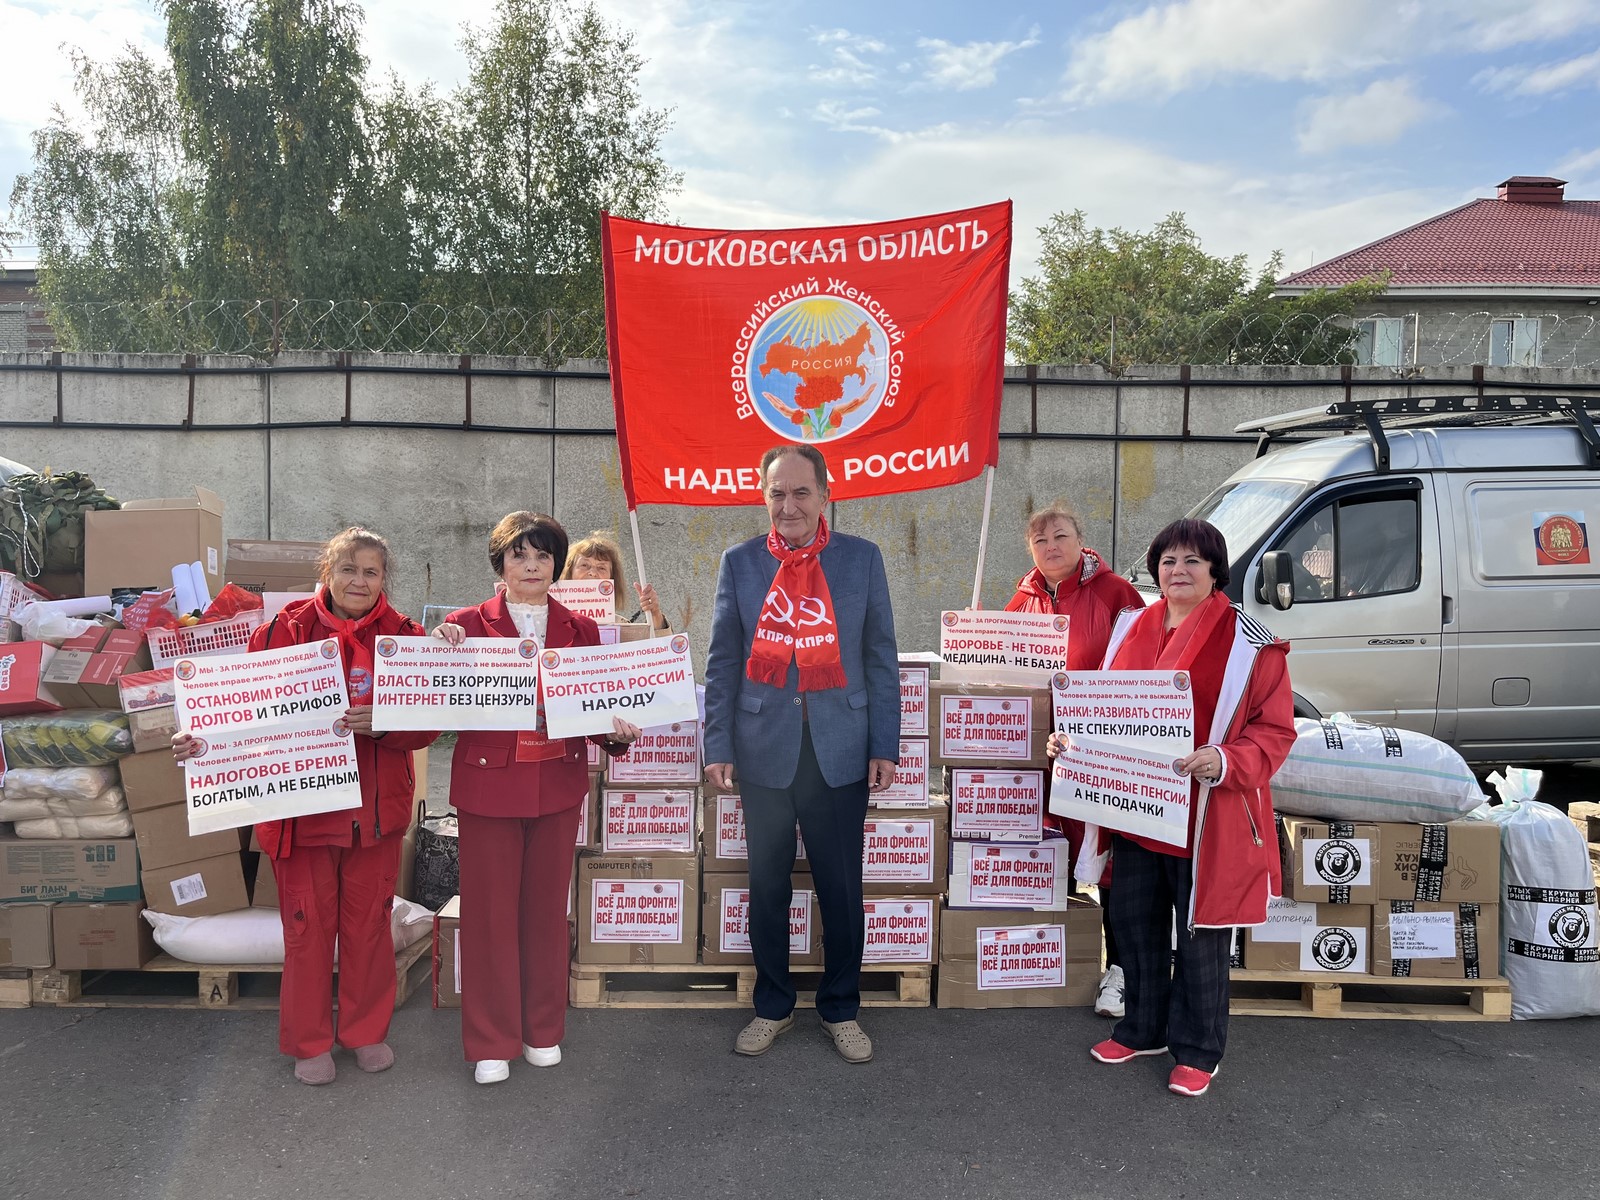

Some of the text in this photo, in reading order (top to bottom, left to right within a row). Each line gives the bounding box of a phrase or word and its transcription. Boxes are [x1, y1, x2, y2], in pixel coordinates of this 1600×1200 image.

[635, 220, 989, 267] МОСКОВСКАЯ ОБЛАСТЬ
[731, 277, 905, 420] Всероссийский Женский Союз
[792, 356, 852, 369] РОССИЯ
[844, 442, 969, 480] РОССИИ
[757, 628, 793, 645] КПРФ
[795, 633, 835, 649] КПРФ
[592, 646, 668, 661] ПРОГРАММУ ПОБЕДЫ!
[944, 640, 1066, 656] ЗДОРОВЬЕ НЕ ТОВАР,
[231, 652, 318, 671] ПРОГРАММУ ПОБЕДЫ!
[582, 668, 608, 676] вправе
[648, 655, 685, 667] выживать!
[943, 654, 1066, 670] МЕДИЦИНА НЕ БАЗАР
[378, 675, 536, 690] ВЛАСТЬ БЕЗ КОРРУПЦИИ
[546, 670, 684, 698] БОГАТСТВА РОССИИ
[186, 688, 272, 710] ОСТАНОВИМ
[275, 682, 309, 698] РОСТ
[312, 676, 339, 693] ЦЕН,
[378, 693, 534, 707] ИНТЕРНЕТ БЕЗ ЦЕНЗУРЫ
[582, 692, 655, 712] НАРОДУ
[190, 693, 341, 730] ДОЛГОВ И ТАРИФОВ
[947, 710, 1025, 726] ВСЁ ДЛЯ ФРОНТА!
[1056, 706, 1191, 719] БАНКИ: РАЗВИВАТЬ СТРАНУ
[946, 726, 1026, 742] ВСЁ ДЛЯ ПОБЕДЫ!
[1059, 723, 1191, 738] А НЕ СПЕКУЛИРОВАТЬ
[634, 735, 694, 748] ДЛЯ ФРОНТА!
[633, 752, 695, 764] ДЛЯ ПОБЕДЫ!
[190, 754, 347, 789] НАЛОГОВОЕ БРЕМЯ
[193, 771, 359, 808] БОГАТЫМ, А НЕ БЕДНЫМ
[959, 785, 1036, 800] ВСЁ ДЛЯ ФРОНТА!
[1056, 766, 1189, 808] СПРАВЕДЛИВЫЕ ПЕНСИИ,
[958, 800, 1037, 815] ВСЁ ДЛЯ ПОБЕДЫ!
[1075, 788, 1164, 818] А НЕ ПОДАЧКИ
[610, 804, 687, 819] ВСЁ ДЛЯ ФРОНТА!
[723, 811, 738, 824] ВСЁ
[609, 820, 688, 834] ВСЁ ДЛЯ ПОБЕДЫ!
[722, 826, 737, 840] ВСЁ
[868, 835, 927, 849] ДЛЯ ФРОНТА!
[1437, 832, 1446, 862] КРУТЫХ
[868, 852, 928, 864] ДЛЯ ПОБЕДЫ!
[1396, 854, 1418, 862] КАХ
[974, 858, 1051, 874] ВСЁ ДЛЯ ФРОНТА!
[1394, 862, 1418, 871] ОИХ
[973, 873, 1052, 889] ВСЁ ДЛЯ ПОБЕДЫ!
[20, 886, 67, 894] БИГ ЛАНЧ
[598, 894, 676, 909] ВСЁ ДЛЯ ФРОНТА!
[597, 910, 677, 925] ВСЁ ДЛЯ ПОБЕДЫ!
[727, 904, 742, 918] ВСЁ
[1551, 908, 1566, 923] СВОИХ
[726, 920, 741, 933] ВСЁ
[868, 916, 926, 930] ДЛЯ ФРОНТА!
[867, 932, 927, 945] ДЛЯ ПОБЕДЫ!
[984, 942, 1059, 956] ВСЁ ДЛЯ ФРОНТА!
[1530, 944, 1564, 954] КРУТЫХ
[983, 957, 1060, 971] ВСЁ ДЛЯ ПОБЕДЫ!
